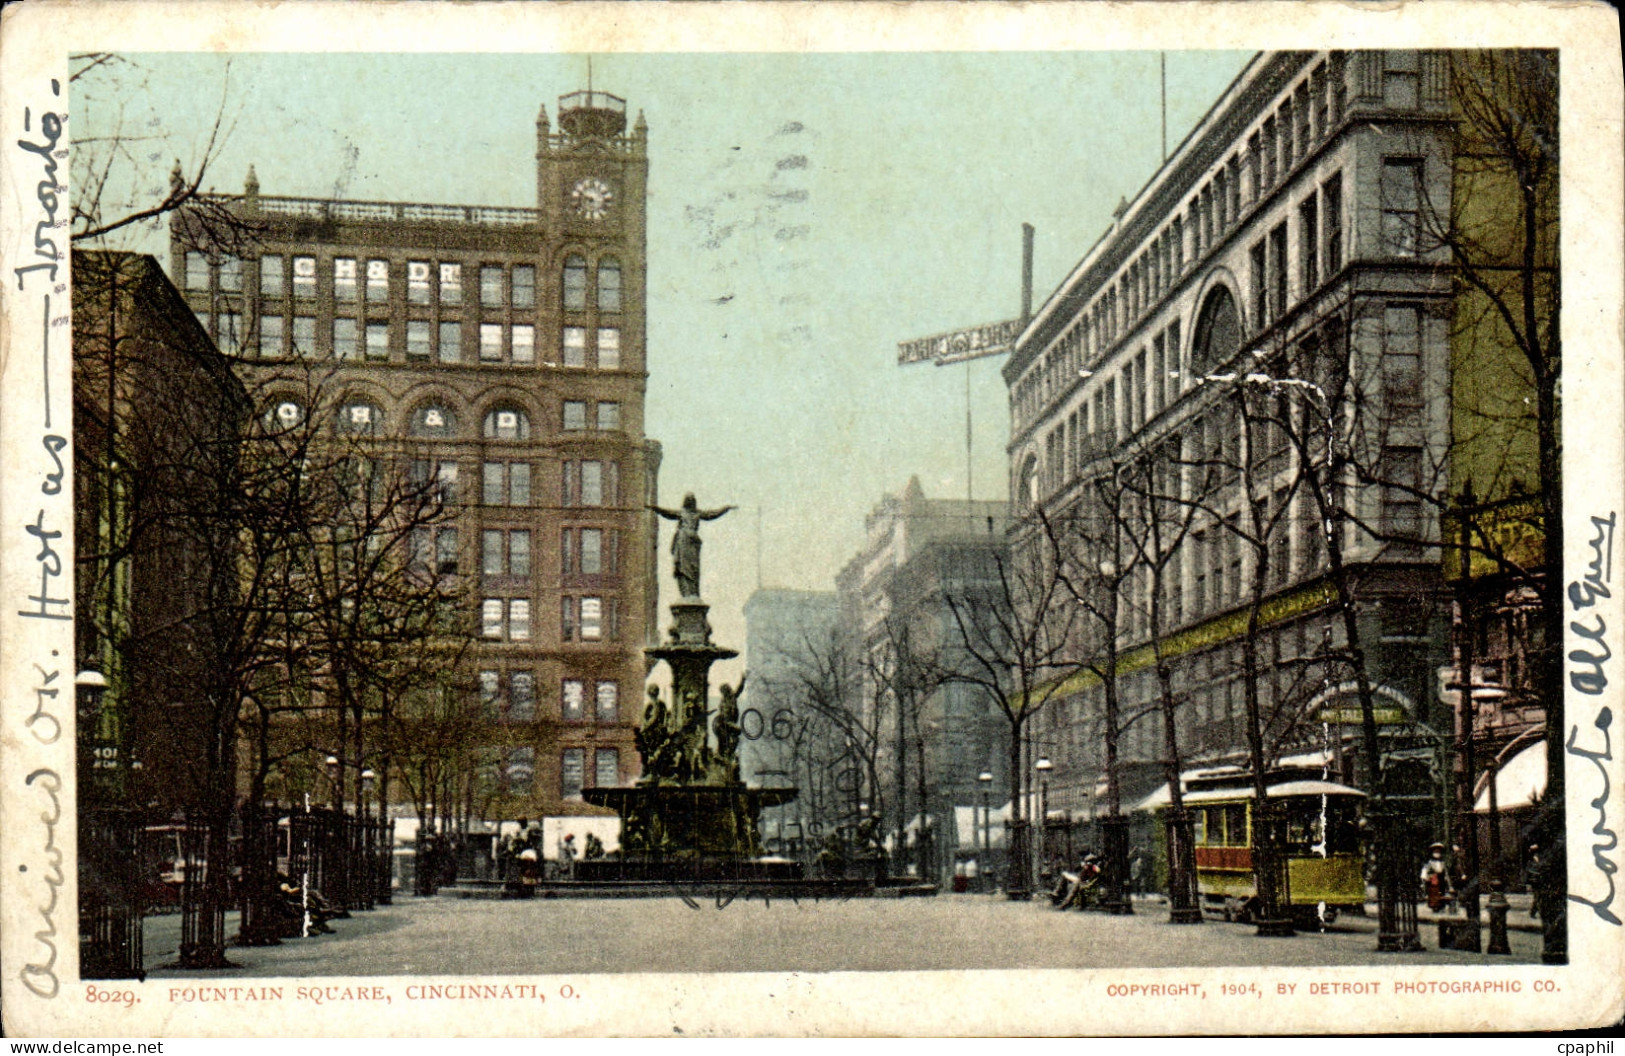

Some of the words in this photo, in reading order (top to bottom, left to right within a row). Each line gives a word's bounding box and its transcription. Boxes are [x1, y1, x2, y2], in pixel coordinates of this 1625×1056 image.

[18, 509, 73, 620] Hot
[85, 985, 142, 1004] 8029.
[169, 986, 284, 1003] FOUNTAIN
[297, 985, 393, 1004] SQUARE,
[406, 984, 546, 1003] CINCINNATI,
[559, 984, 581, 1000] O.
[1107, 983, 1207, 999] COPYRIGHT,
[1221, 982, 1263, 998] 1904,
[1277, 982, 1298, 995] BY
[1310, 981, 1382, 995] DETROIT
[1395, 980, 1522, 994] PHOTOGRAPHIC
[1533, 980, 1561, 993] CO.
